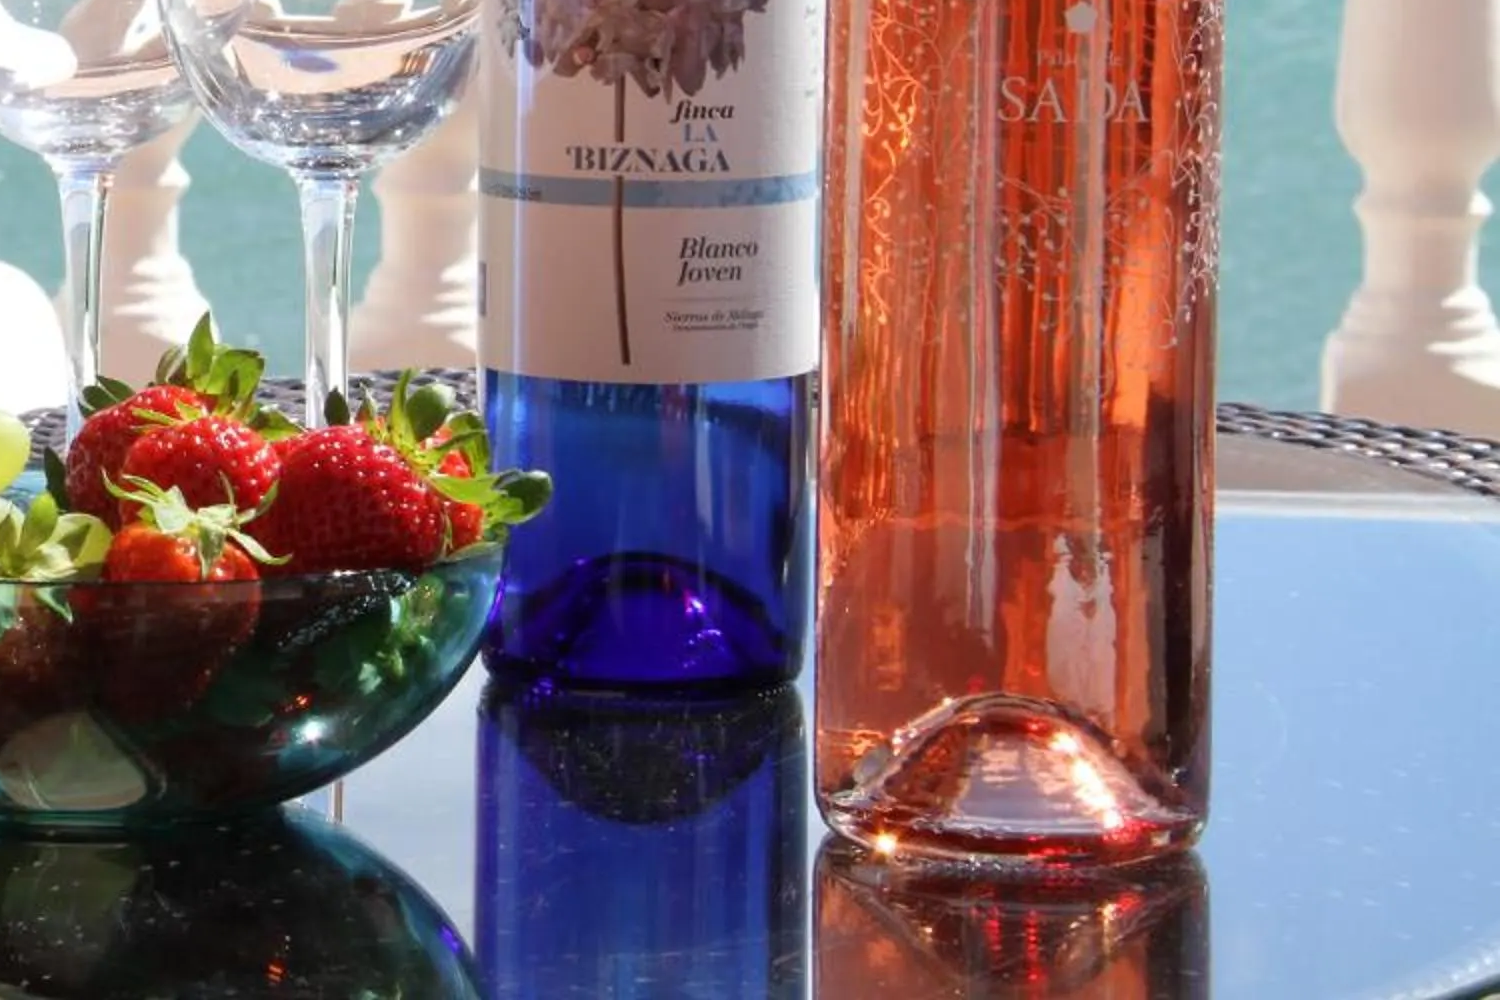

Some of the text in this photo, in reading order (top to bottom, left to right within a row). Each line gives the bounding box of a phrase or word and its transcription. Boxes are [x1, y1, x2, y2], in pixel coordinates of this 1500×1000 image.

[671, 100, 735, 124] finca
[683, 122, 718, 143] LA
[565, 145, 730, 173] BIZNAGA
[679, 235, 760, 260] Blanco
[676, 261, 742, 288] Joven
